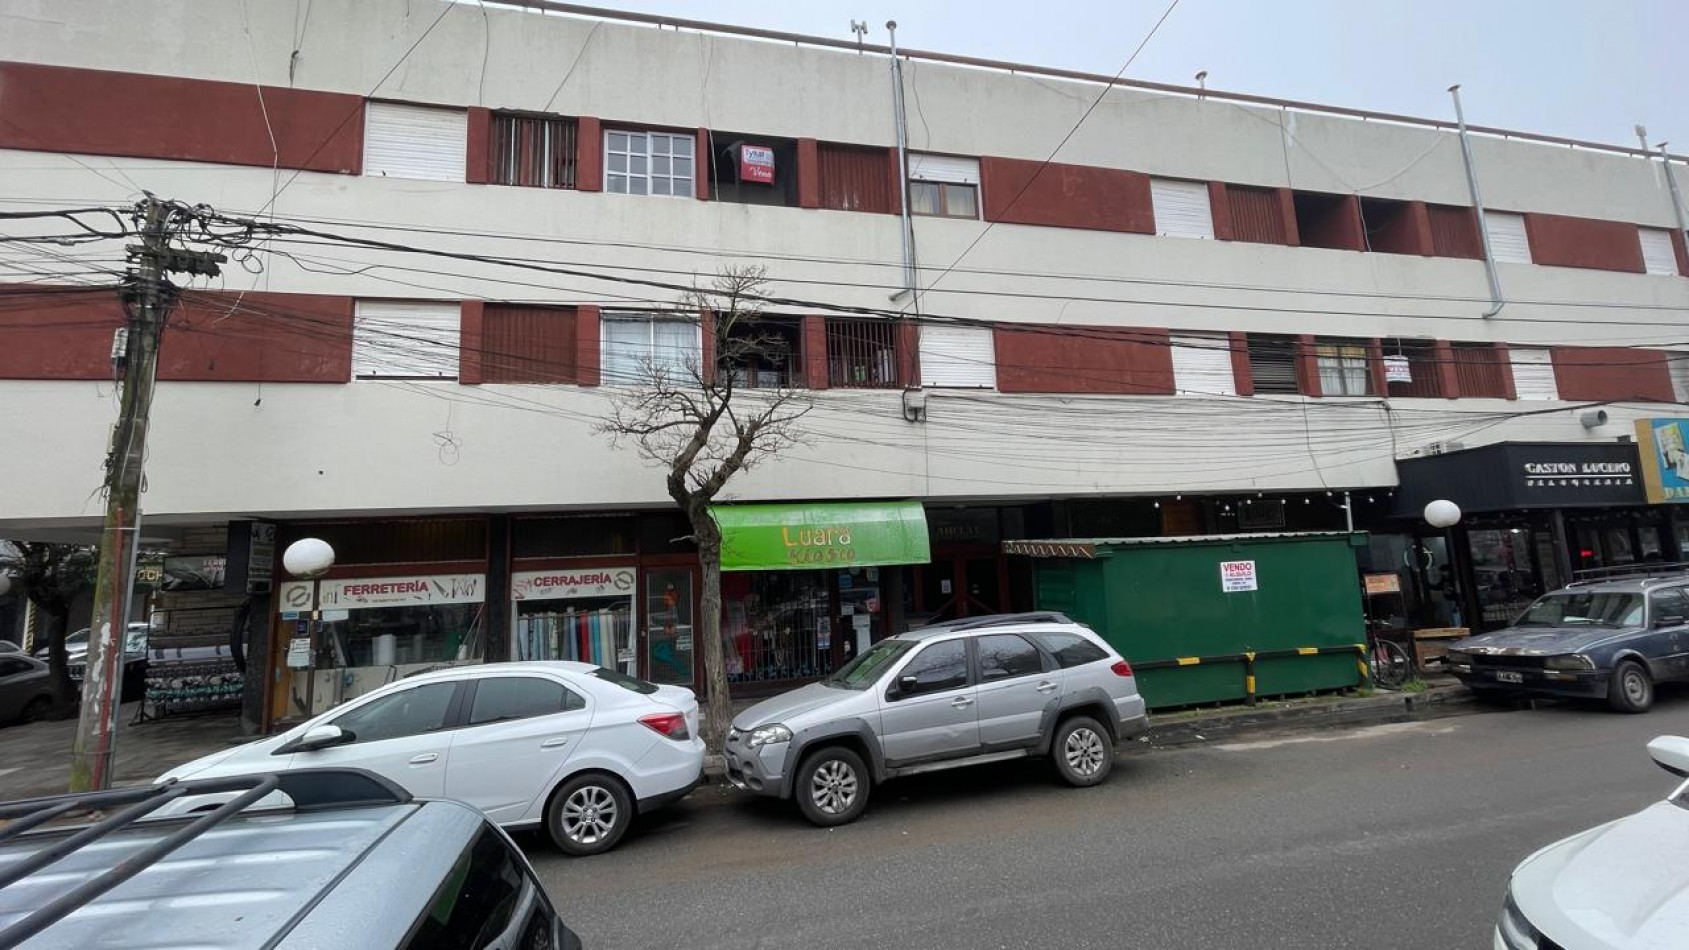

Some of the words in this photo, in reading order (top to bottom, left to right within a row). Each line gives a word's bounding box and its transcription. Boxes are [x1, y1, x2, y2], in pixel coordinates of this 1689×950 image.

[1525, 463, 1577, 473] GASTON
[1582, 463, 1631, 473] LUCERO
[1223, 563, 1252, 571] VENDO
[533, 573, 612, 588] CERRAJERÍA
[343, 580, 429, 596] FERRETERÍA
